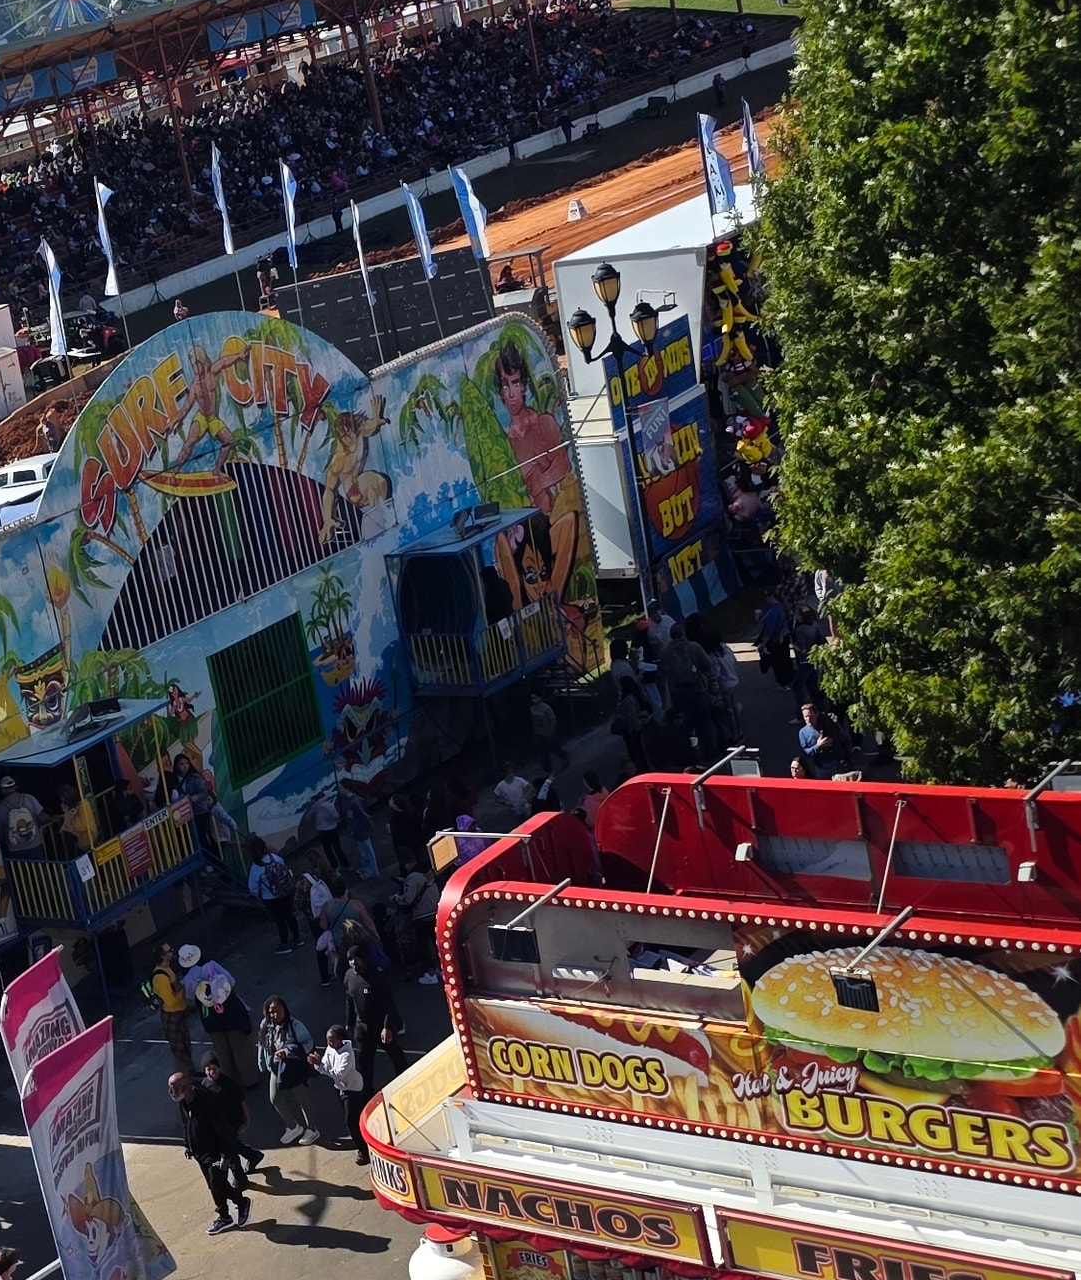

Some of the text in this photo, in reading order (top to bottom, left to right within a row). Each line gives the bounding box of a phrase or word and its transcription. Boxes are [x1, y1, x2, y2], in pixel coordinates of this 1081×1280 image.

[645, 356, 660, 391] IN
[659, 335, 691, 377] WINS
[80, 335, 331, 535] SURF CITY
[657, 484, 695, 539] BUT
[668, 539, 704, 586] NET
[524, 604, 536, 616] EXIT
[145, 809, 168, 829] ENTER
[81, 863, 91, 877] 31
[490, 1038, 668, 1097] CORN DOGS
[732, 1061, 860, 1101] Hot & Juicy
[785, 1089, 1072, 1168] BURGERS
[439, 1174, 680, 1249] NACHOS
[519, 1251, 549, 1268] FRIES
